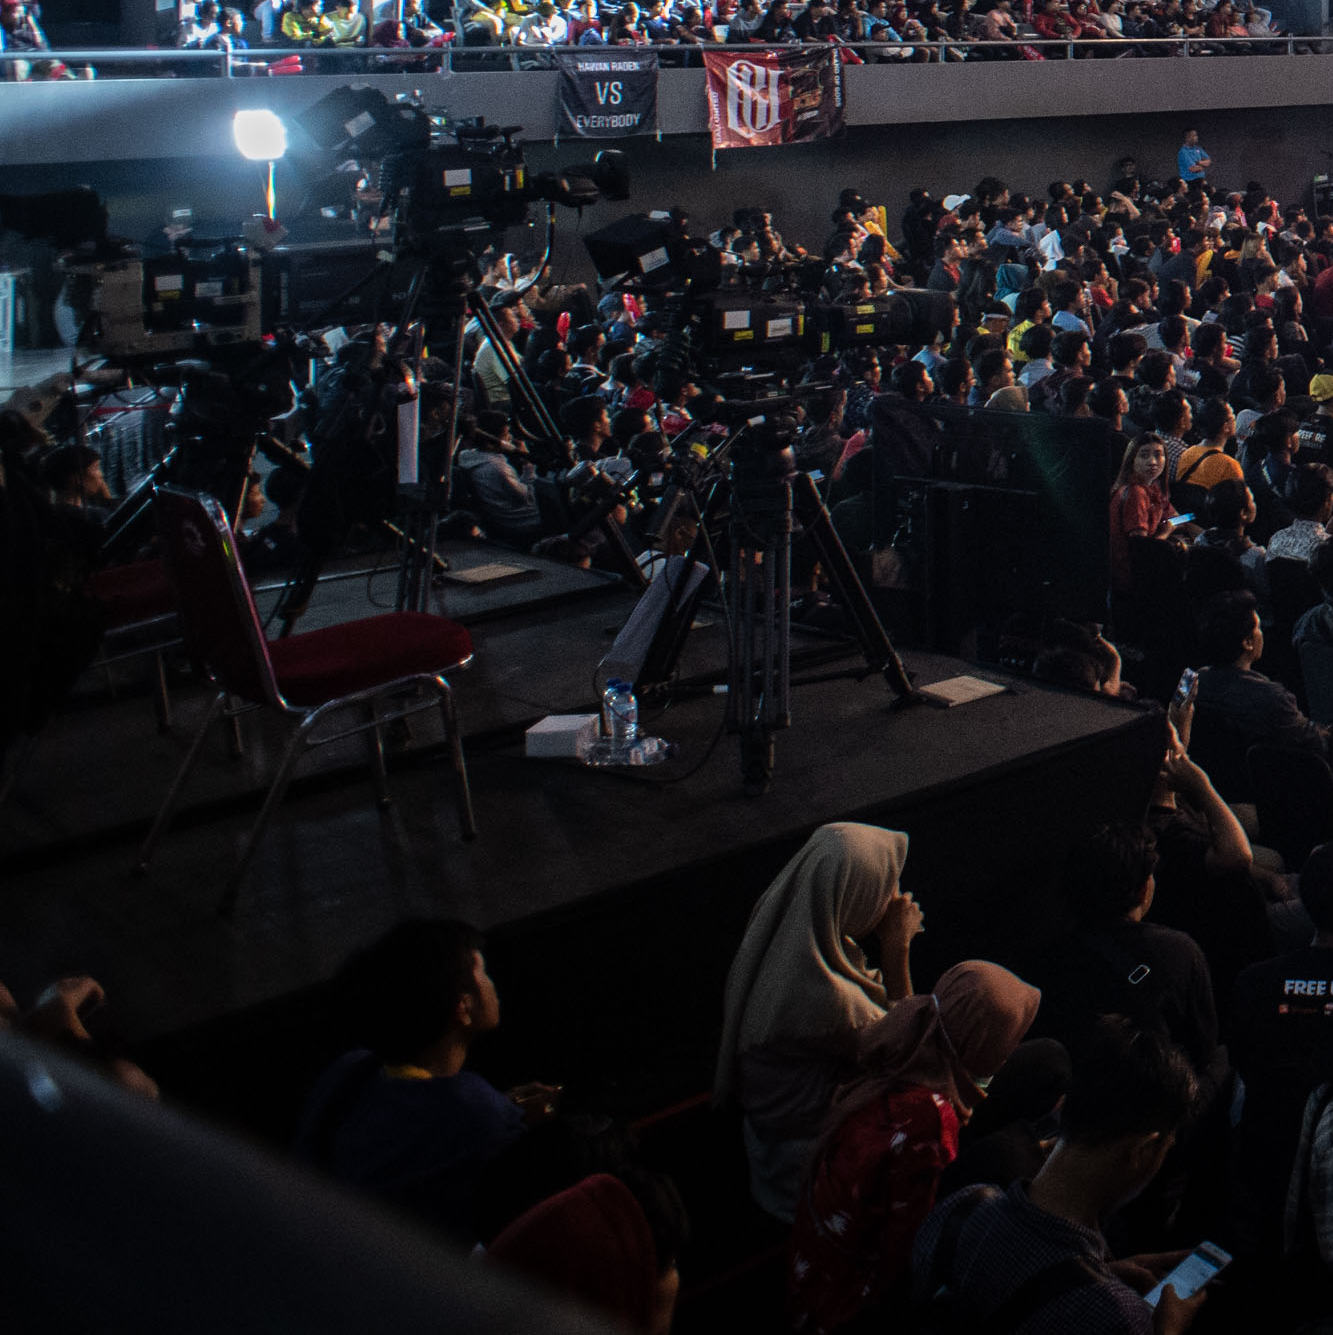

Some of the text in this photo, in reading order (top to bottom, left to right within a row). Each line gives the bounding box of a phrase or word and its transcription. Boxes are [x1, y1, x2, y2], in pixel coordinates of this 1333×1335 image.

[594, 80, 623, 105] VS
[576, 112, 641, 128] EVERYBODY
[1283, 979, 1326, 997] FREE
